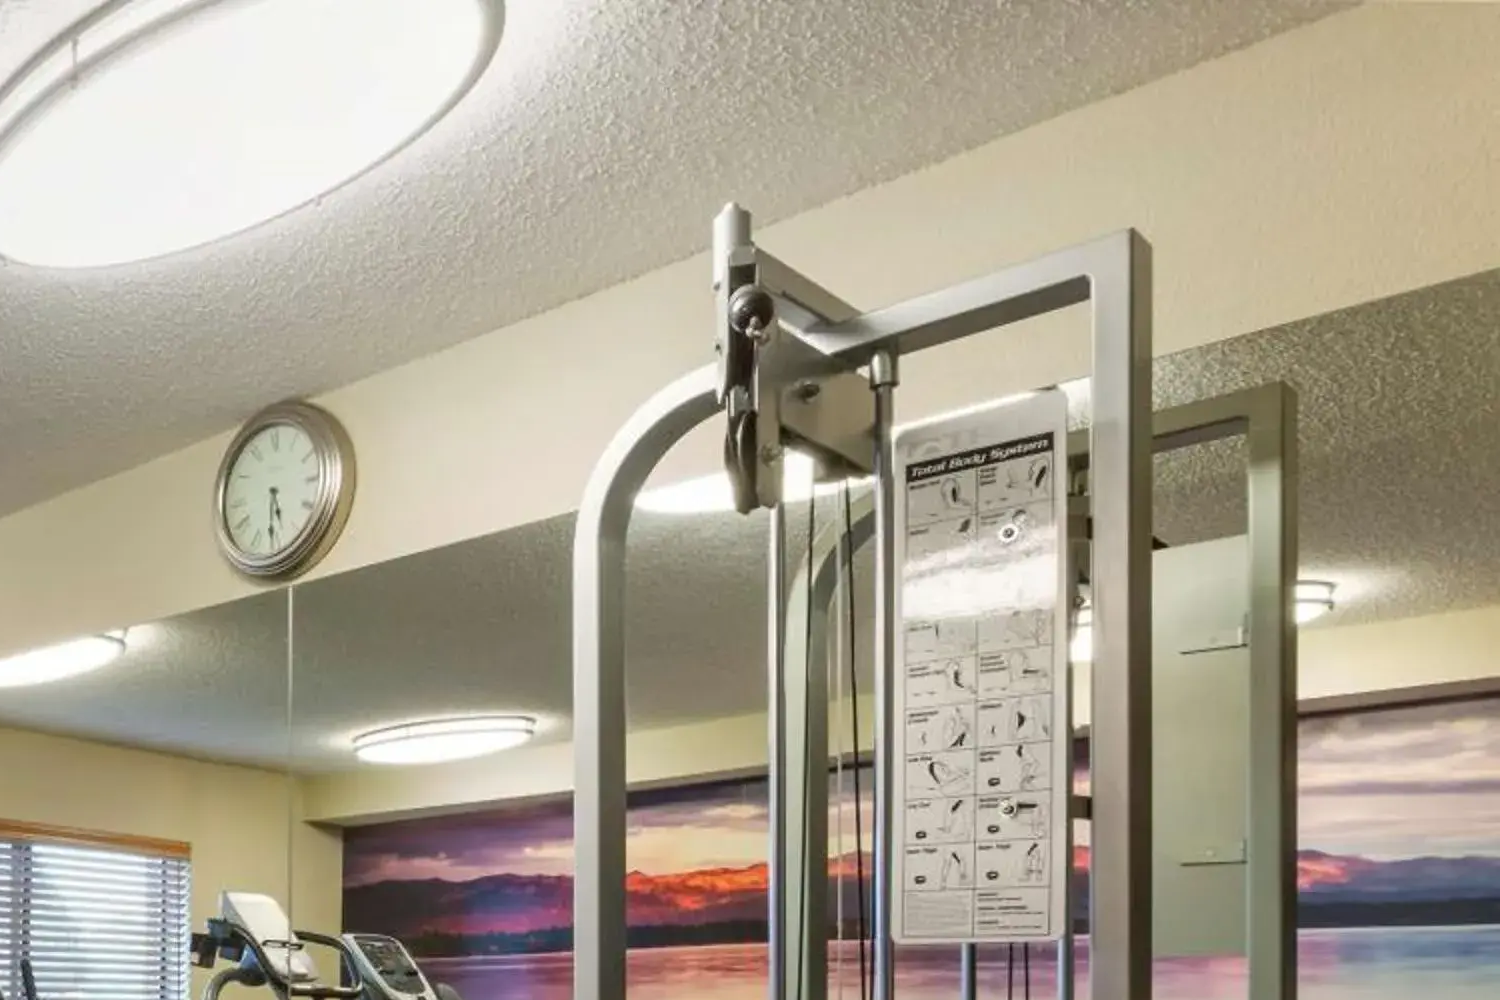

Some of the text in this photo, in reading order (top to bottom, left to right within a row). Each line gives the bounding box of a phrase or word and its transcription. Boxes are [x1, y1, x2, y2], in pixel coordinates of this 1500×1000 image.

[911, 461, 948, 477] Total
[949, 453, 988, 469] Body
[990, 440, 1048, 460] System
